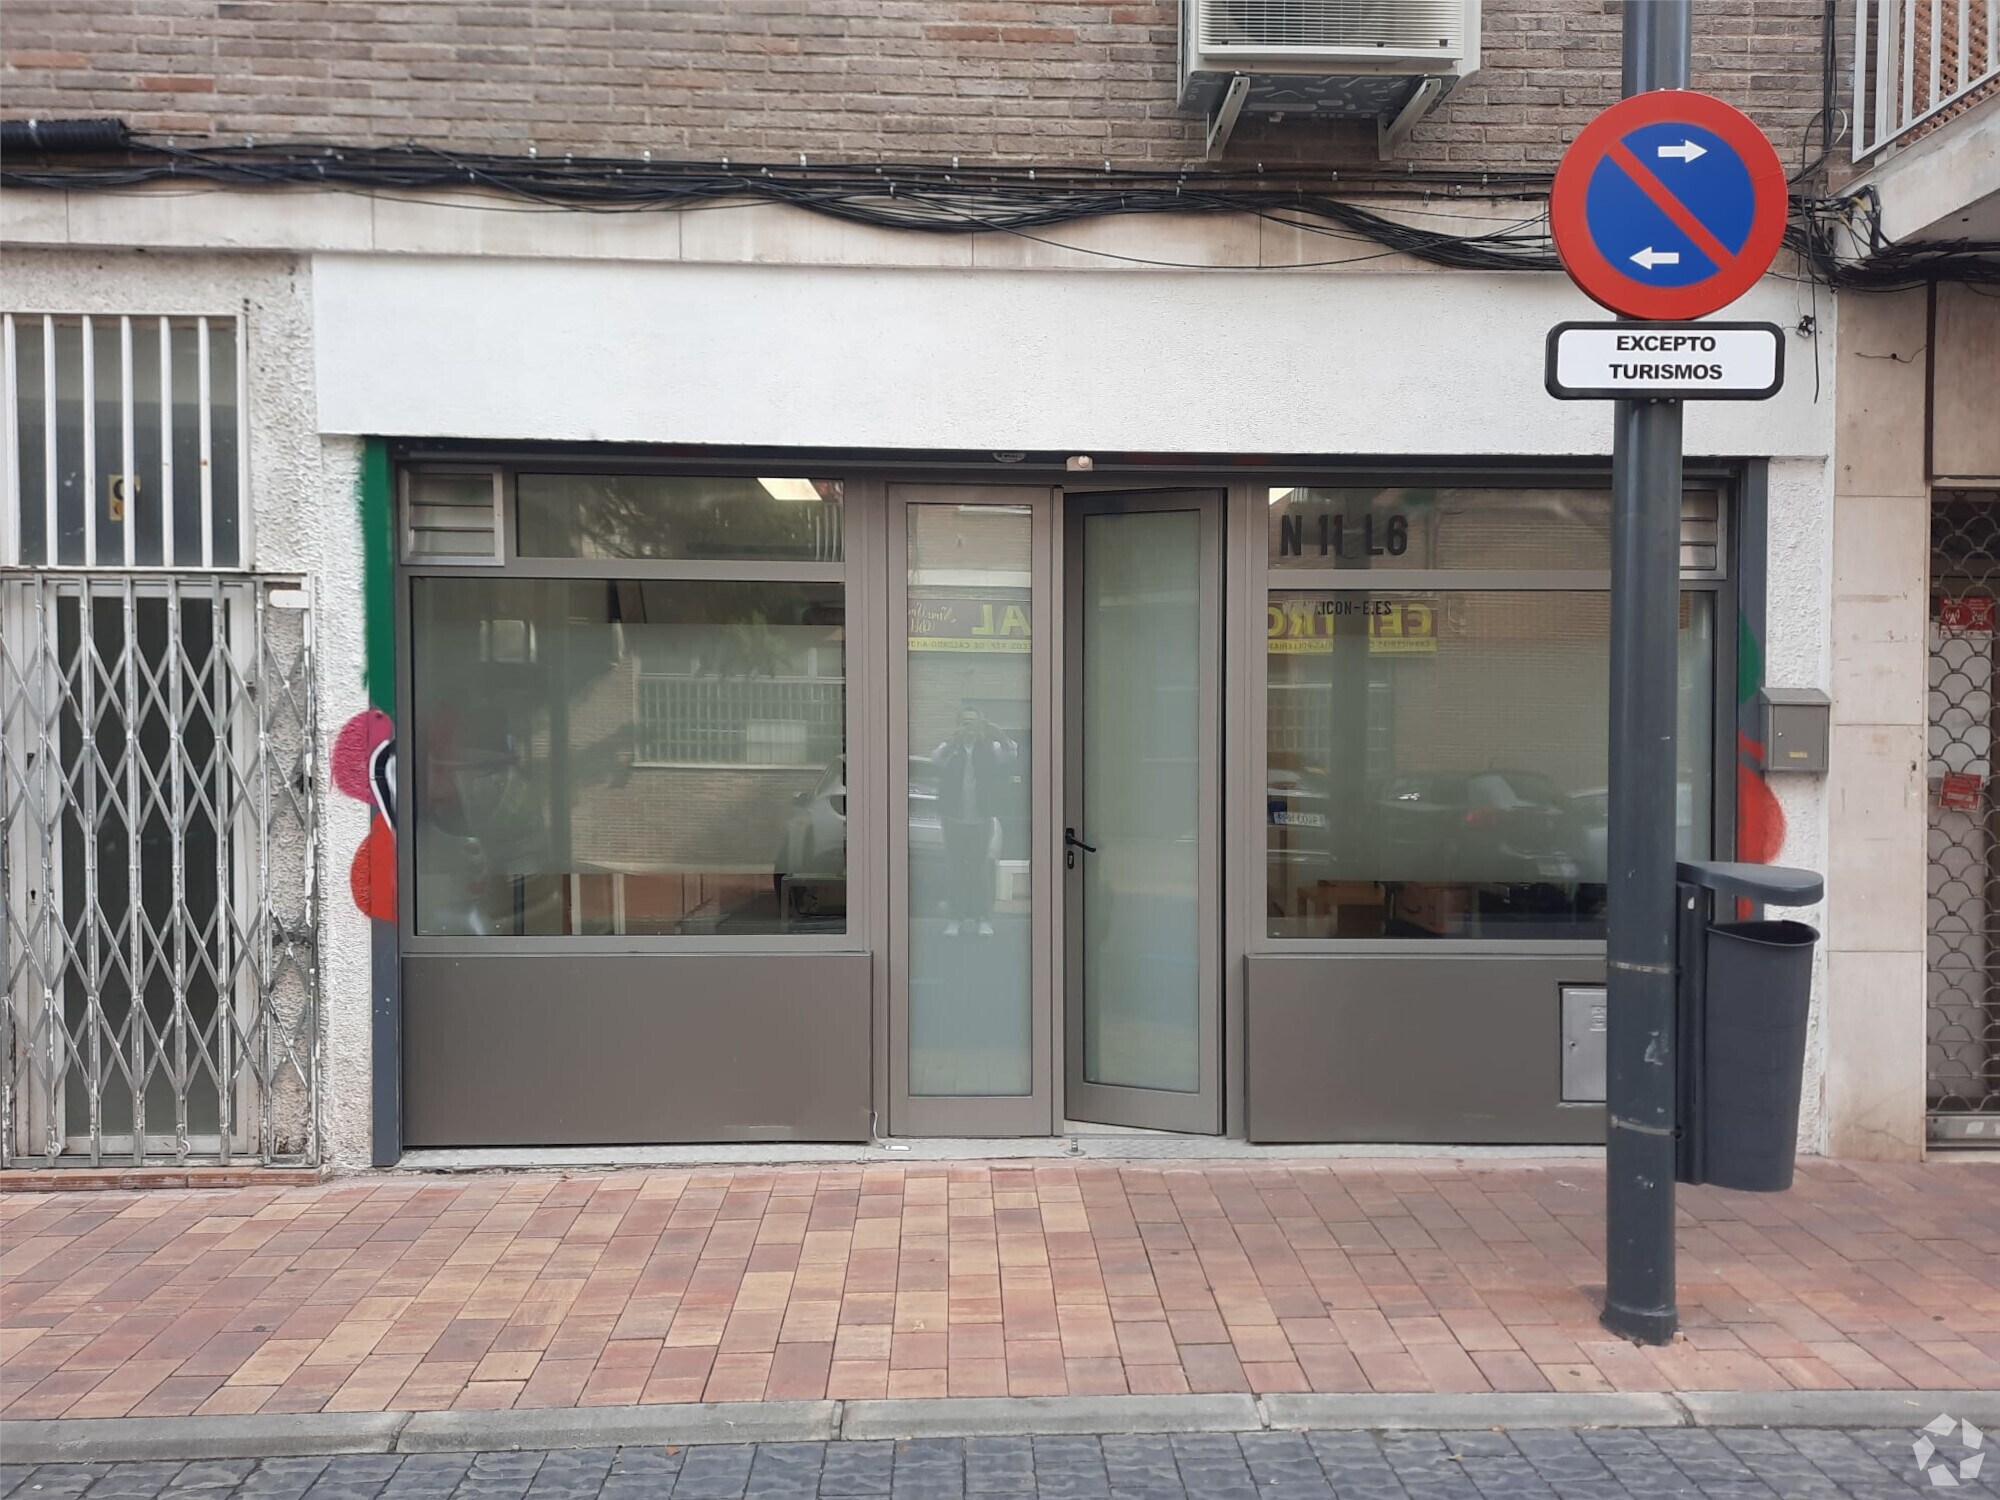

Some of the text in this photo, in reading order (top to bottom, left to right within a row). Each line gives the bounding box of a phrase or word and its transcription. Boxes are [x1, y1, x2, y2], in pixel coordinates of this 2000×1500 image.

[1616, 335, 1716, 352] EXCEPTO
[1608, 364, 1723, 380] TURISMOS
[1280, 513, 1409, 557] N 11 L6
